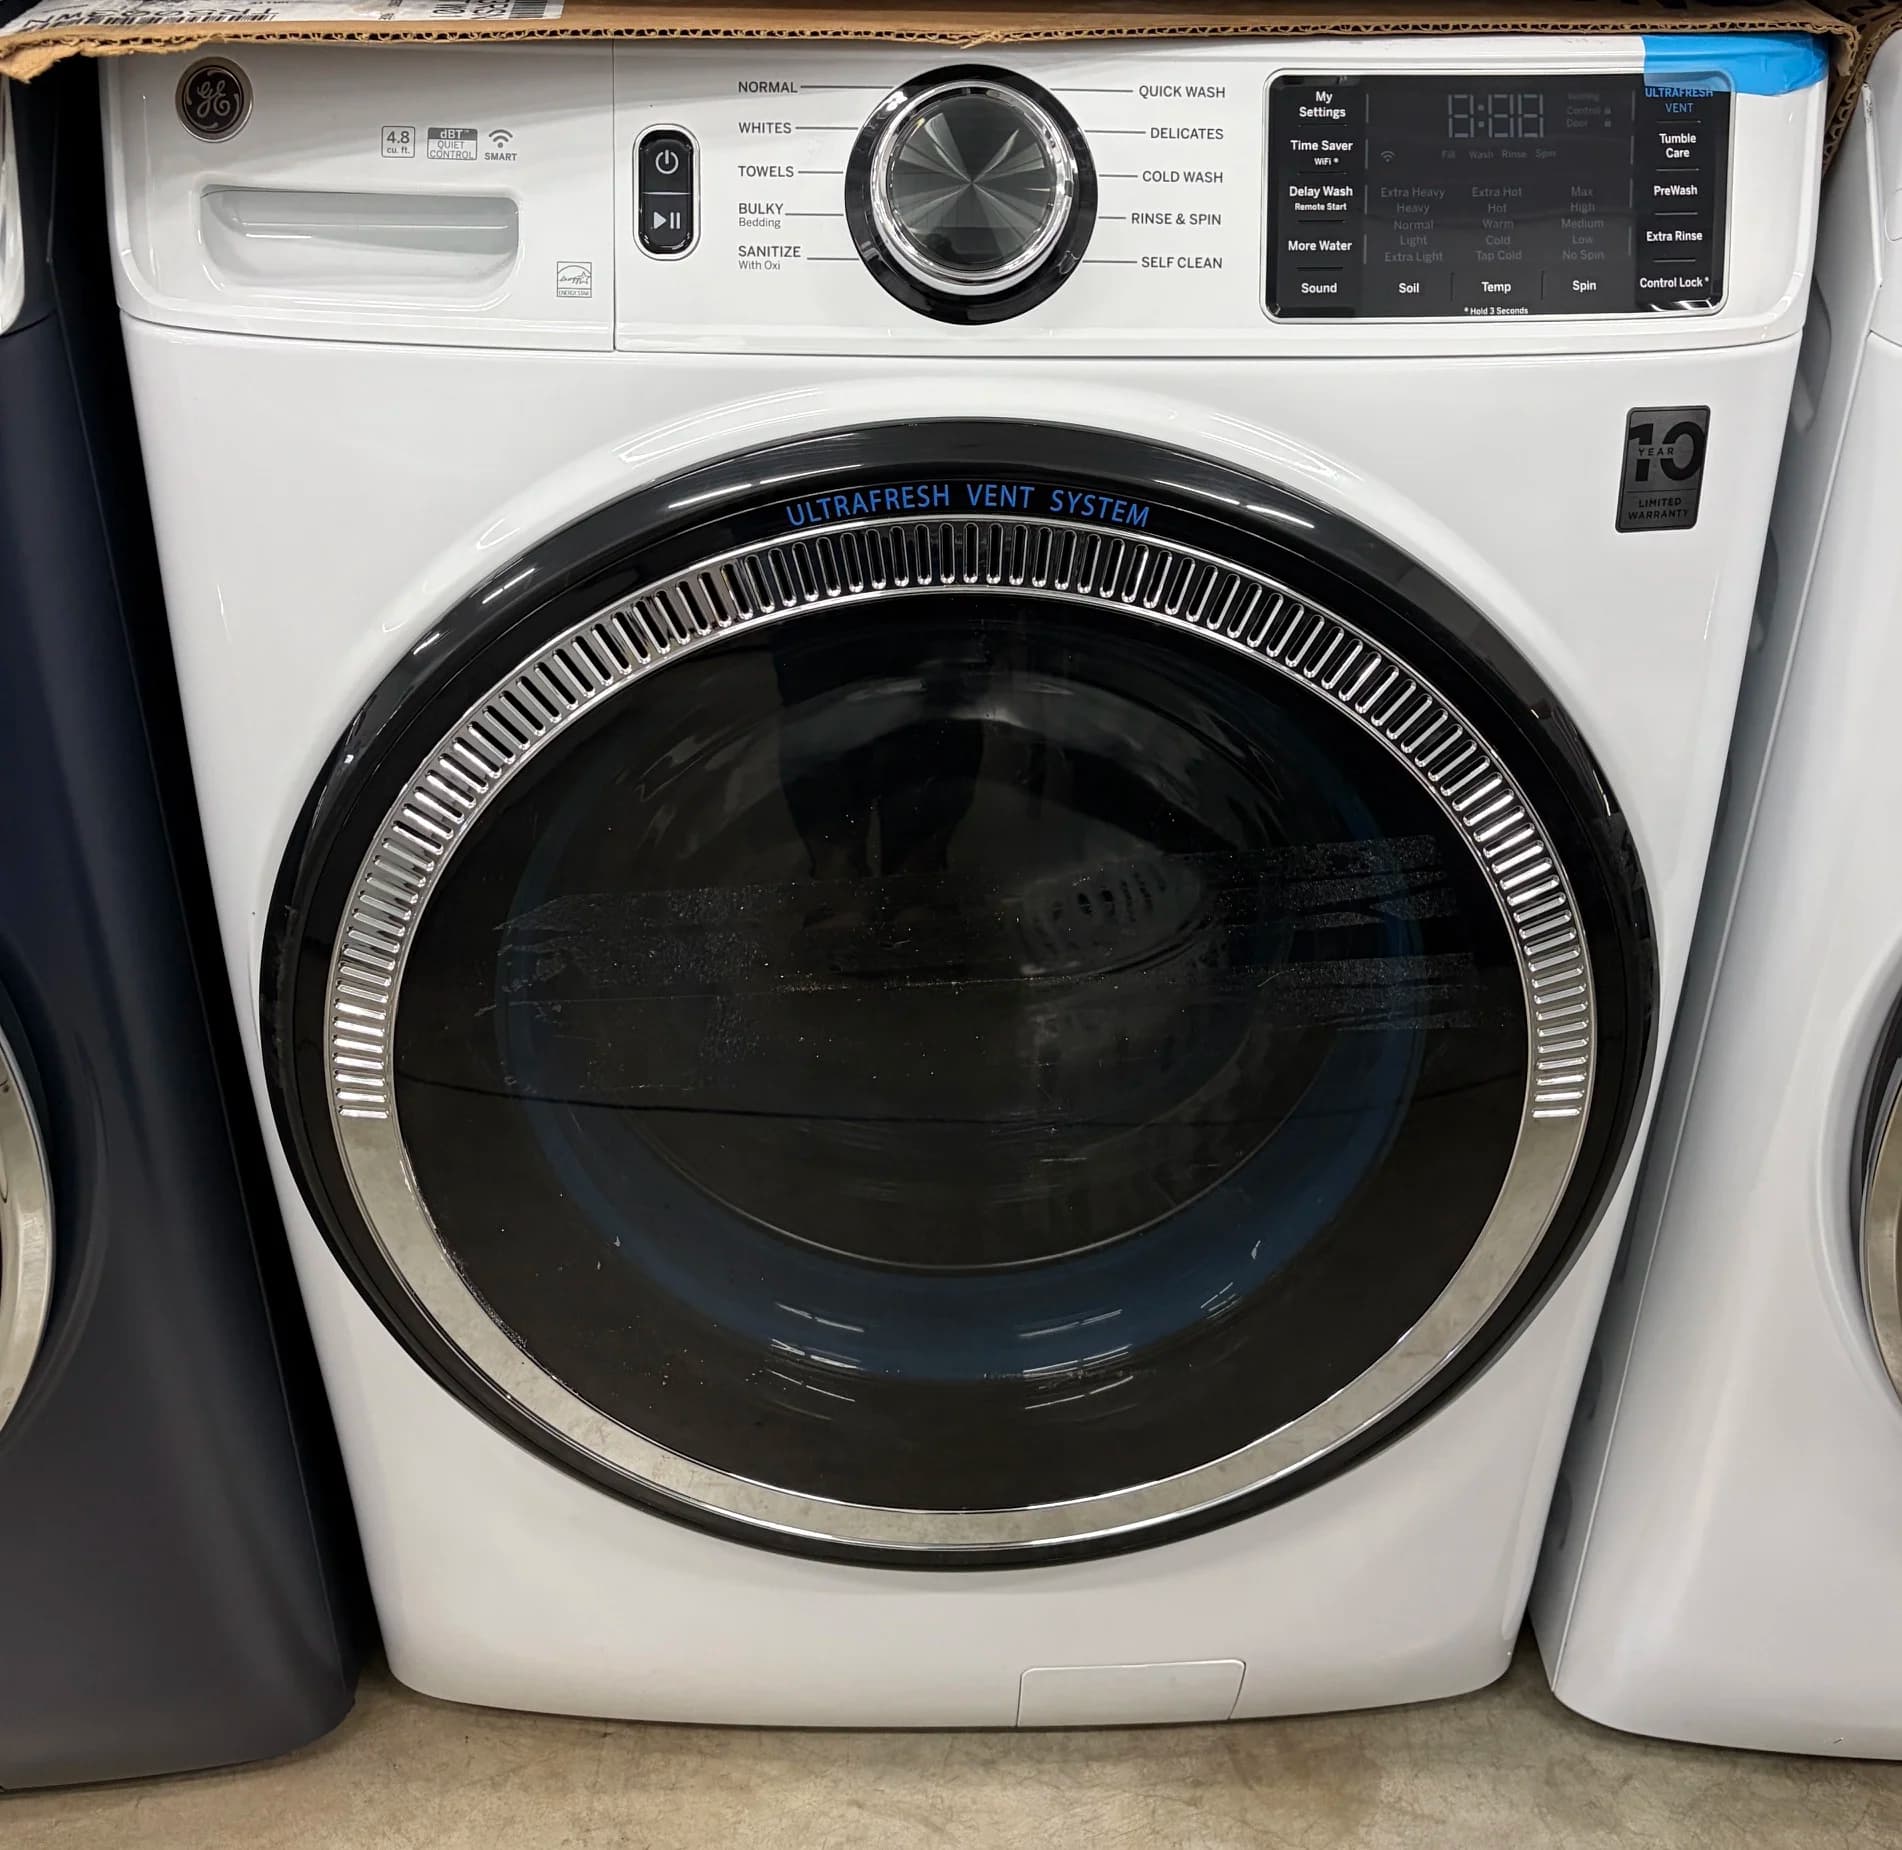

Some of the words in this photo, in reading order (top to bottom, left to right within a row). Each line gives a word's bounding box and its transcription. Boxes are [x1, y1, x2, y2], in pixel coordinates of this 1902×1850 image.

[738, 81, 798, 93] NORMAL
[1138, 85, 1182, 99] QUICK
[1185, 86, 1225, 98] WASH
[1645, 87, 1713, 98] ULTRAFRESH
[1315, 90, 1333, 104] My
[1299, 106, 1346, 119] Settings
[1665, 102, 1694, 113] VENT
[738, 122, 792, 134] WHITES
[1150, 127, 1224, 140] DELICATES
[387, 130, 410, 144] 4.8
[1658, 133, 1697, 144] Tumble
[401, 146, 410, 154] ft.
[437, 141, 465, 149] QUIET
[1289, 139, 1319, 151] Time
[1321, 139, 1354, 151] Saver
[429, 150, 474, 159] CONTROL
[484, 152, 518, 160] SMART
[1665, 147, 1690, 158] Care
[1314, 157, 1332, 166] WiFi
[737, 165, 794, 177] TOWELS
[1142, 170, 1180, 182] COLD
[1183, 171, 1223, 183] WASH
[1289, 186, 1321, 199] Delay
[1322, 185, 1353, 196] Wash
[1381, 187, 1409, 198] Extra
[1412, 187, 1446, 199] Heavy
[1472, 187, 1500, 197] Extra
[1503, 186, 1522, 197] Hot
[1571, 186, 1593, 197] Max
[1653, 185, 1698, 196] PreWash
[738, 202, 784, 215] BULKY
[1294, 202, 1325, 211] Remote
[1326, 202, 1347, 211] Start
[1396, 203, 1430, 215] Heavy
[1487, 203, 1507, 213] Hot
[1570, 202, 1596, 214] High
[738, 217, 781, 229] Bedding
[1131, 212, 1172, 224] RINSE
[1175, 213, 1186, 225] &
[1189, 213, 1222, 225] SPIN
[1393, 219, 1434, 230] Normal
[1482, 218, 1515, 229] Warm
[1561, 218, 1604, 229] Medium
[1400, 235, 1428, 247] Light
[1485, 235, 1511, 245] Cold
[1572, 235, 1593, 245] Low
[1646, 231, 1673, 242] Extra
[1675, 230, 1703, 241] Rinse
[738, 245, 801, 257] SANITIZE
[1287, 240, 1317, 251] More
[1318, 240, 1353, 251] Water
[1384, 251, 1414, 262] Extra
[1416, 251, 1443, 264] Light
[1476, 250, 1495, 261] Tap
[1497, 250, 1522, 260] Cold
[1562, 249, 1578, 260] No
[1581, 249, 1606, 261] Spin
[738, 260, 762, 270] With
[764, 260, 781, 270] Oxi
[1141, 256, 1175, 268] SELF
[1177, 256, 1223, 269] CLEAN
[1301, 282, 1338, 293] Sound
[1398, 282, 1420, 294] Soil
[1481, 281, 1512, 294] Temp
[1572, 280, 1597, 293] Spin
[1639, 276, 1677, 288] Control
[1679, 276, 1703, 287] Lock
[1470, 306, 1488, 315] Hold
[1489, 306, 1495, 314] 3
[1496, 305, 1529, 314] Seconds
[1628, 421, 1706, 481] 10
[1638, 447, 1674, 457] YEAR
[785, 484, 950, 527] ULTRAFRESH
[966, 483, 1035, 509] VENT
[1050, 489, 1150, 528] SYSTEM
[1638, 497, 1682, 508] LIMITED
[1628, 508, 1689, 520] WARRANTY
